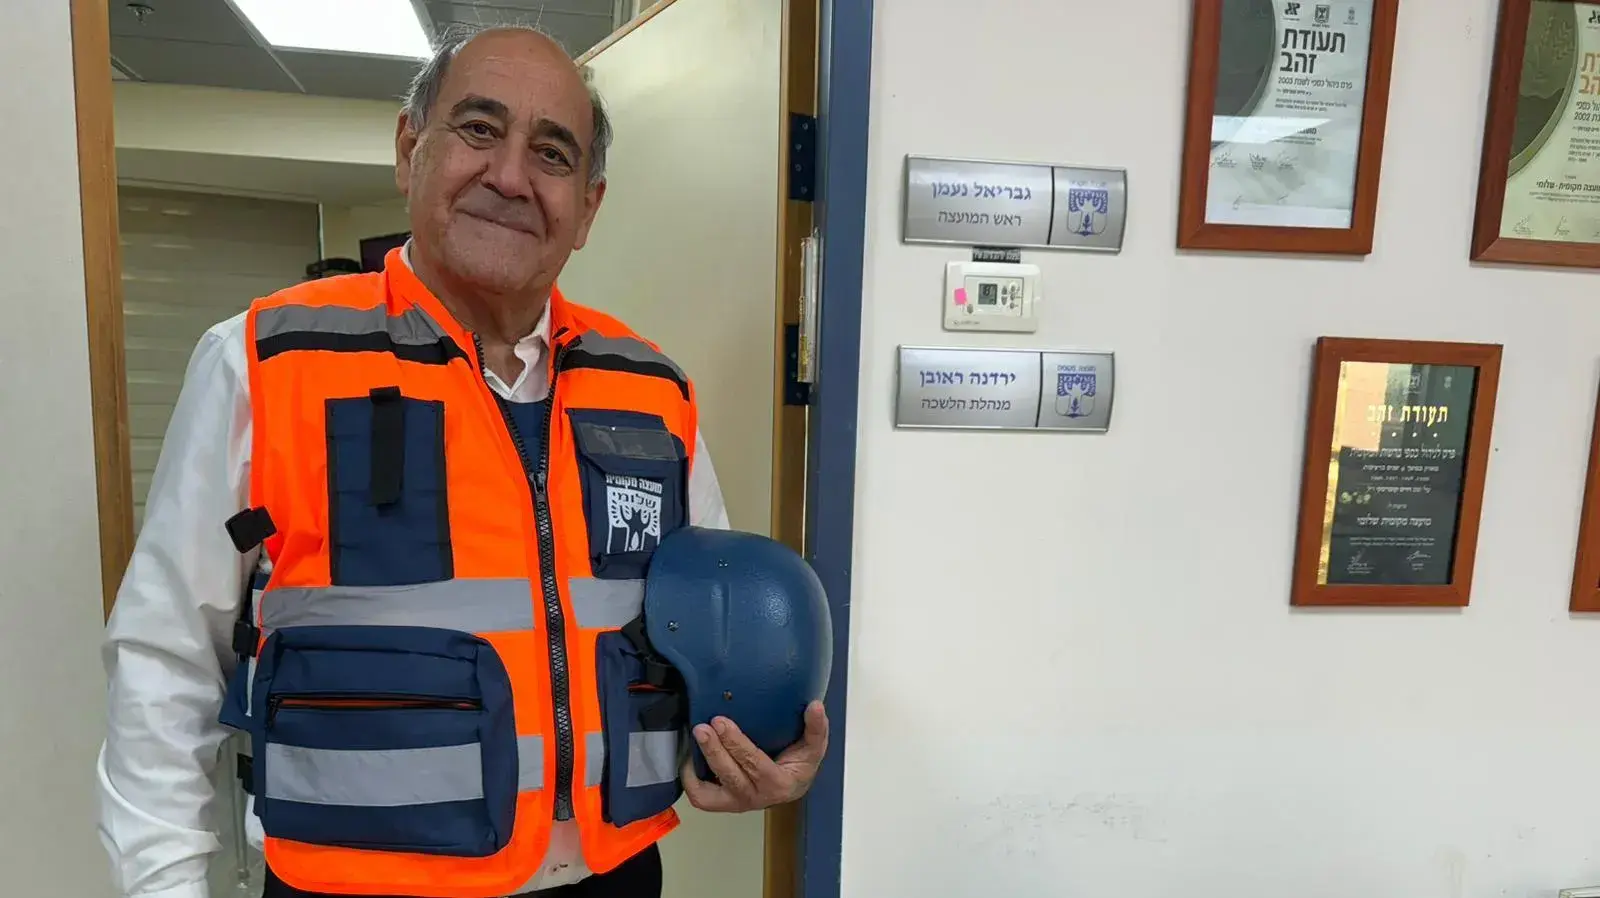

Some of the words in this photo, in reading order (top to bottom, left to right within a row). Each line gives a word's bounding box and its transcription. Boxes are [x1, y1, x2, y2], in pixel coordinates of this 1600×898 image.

[1281, 28, 1346, 53] תעודת
[1279, 51, 1317, 74] זהב
[1574, 111, 1591, 121] 2002
[931, 181, 969, 199] נעמן
[973, 181, 1032, 201] גבריאל
[938, 210, 989, 225] המועצה
[993, 211, 1022, 227] ראש
[919, 371, 964, 388] ראובן
[969, 372, 1017, 386] ירדנה
[921, 396, 966, 411] הלשכה
[969, 397, 1011, 411] מנהלת
[1367, 403, 1394, 422] זהב
[1400, 404, 1449, 428] תעודת
[606, 475, 637, 489] מקומית
[639, 478, 662, 494] מועצה
[613, 492, 656, 508] שלומי
